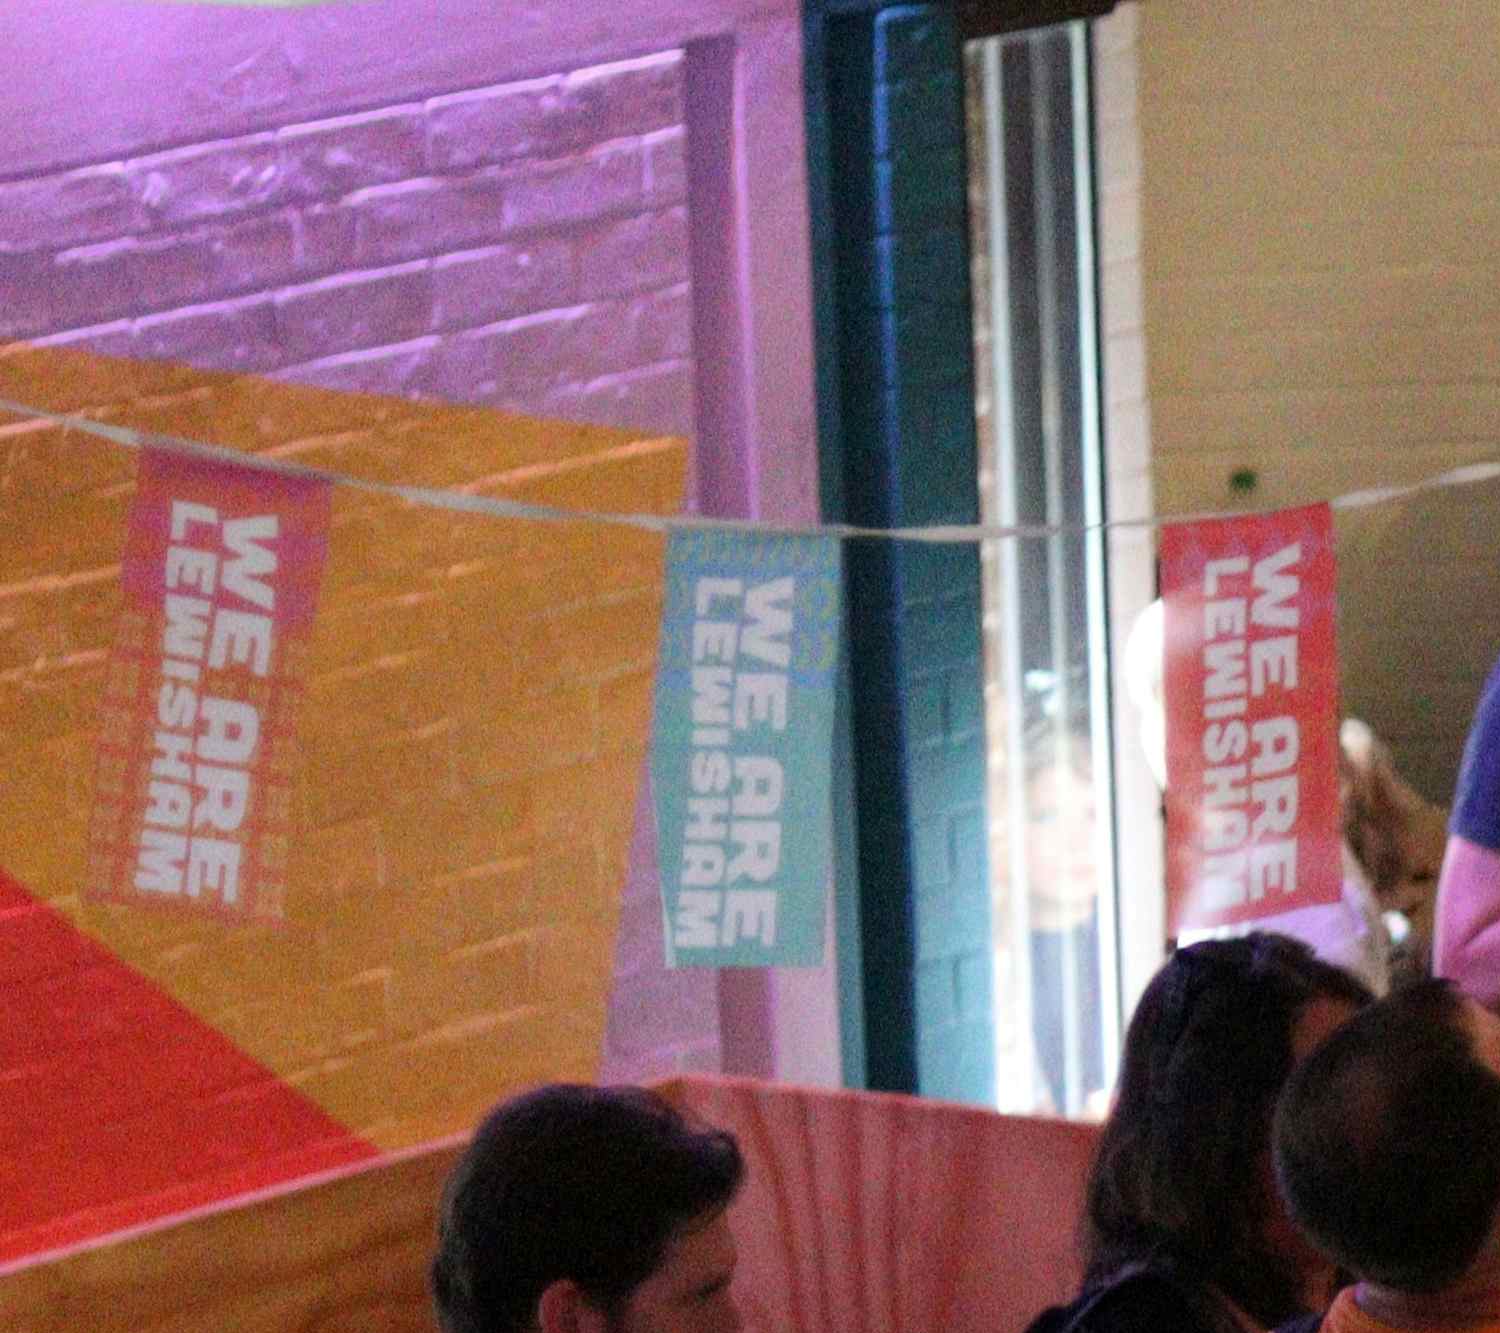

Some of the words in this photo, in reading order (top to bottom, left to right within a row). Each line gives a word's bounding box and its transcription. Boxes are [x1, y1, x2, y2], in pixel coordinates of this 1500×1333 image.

[208, 514, 280, 678] WE
[733, 576, 796, 731] WE
[1251, 547, 1301, 697] WE
[133, 500, 219, 896] LEWISHAM
[675, 577, 745, 949] LEWISHAM
[1203, 556, 1251, 912] LEWISHAM
[187, 695, 262, 905] ARE
[722, 755, 784, 947] ARE
[1250, 715, 1301, 901] ARE
